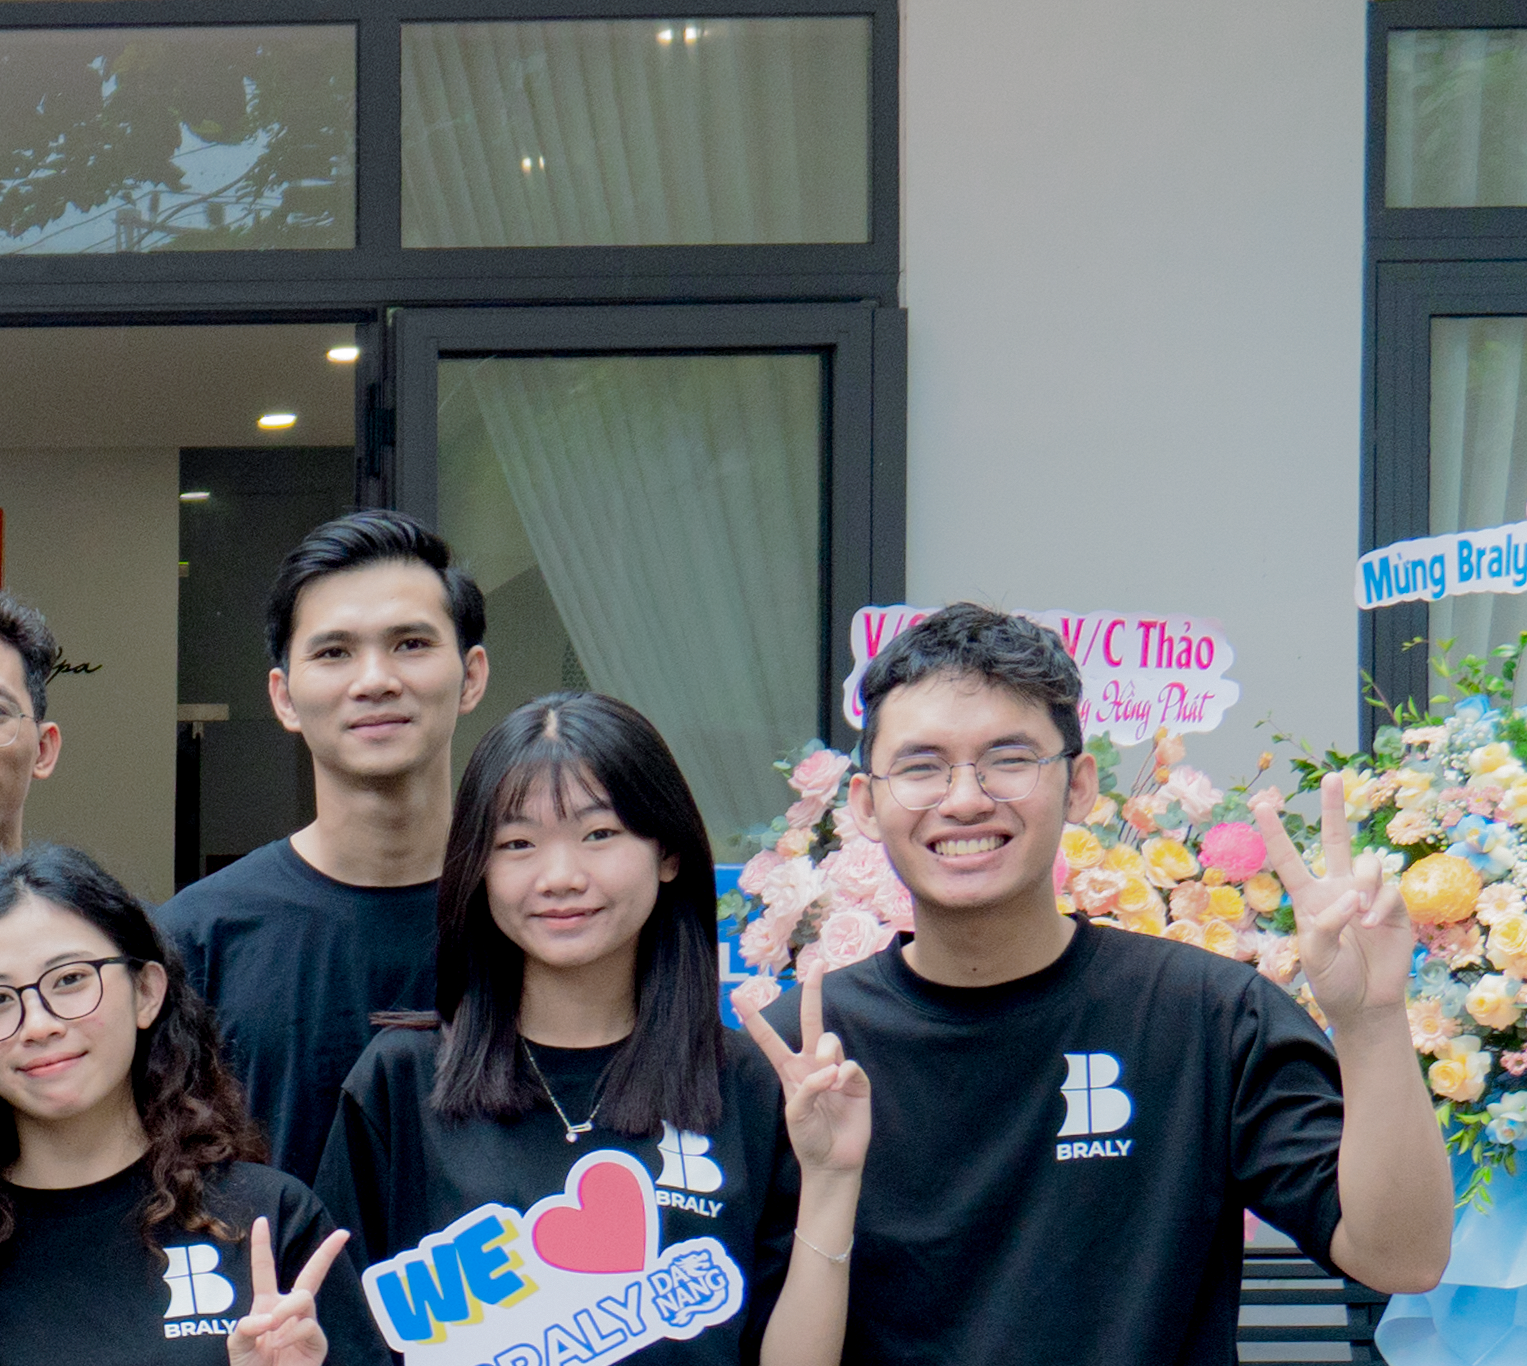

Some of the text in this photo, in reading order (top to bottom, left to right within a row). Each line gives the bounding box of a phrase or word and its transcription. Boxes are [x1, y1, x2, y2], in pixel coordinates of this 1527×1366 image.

[1362, 533, 1527, 606] Mừng Braly
[1060, 617, 1126, 669] V/C
[1136, 619, 1215, 671] Thảo
[1056, 1140, 1132, 1161] BRALY
[656, 1190, 724, 1219] BRALY
[376, 1214, 534, 1343] WE
[652, 1268, 727, 1319] NANG
[164, 1319, 237, 1339] BRALY
